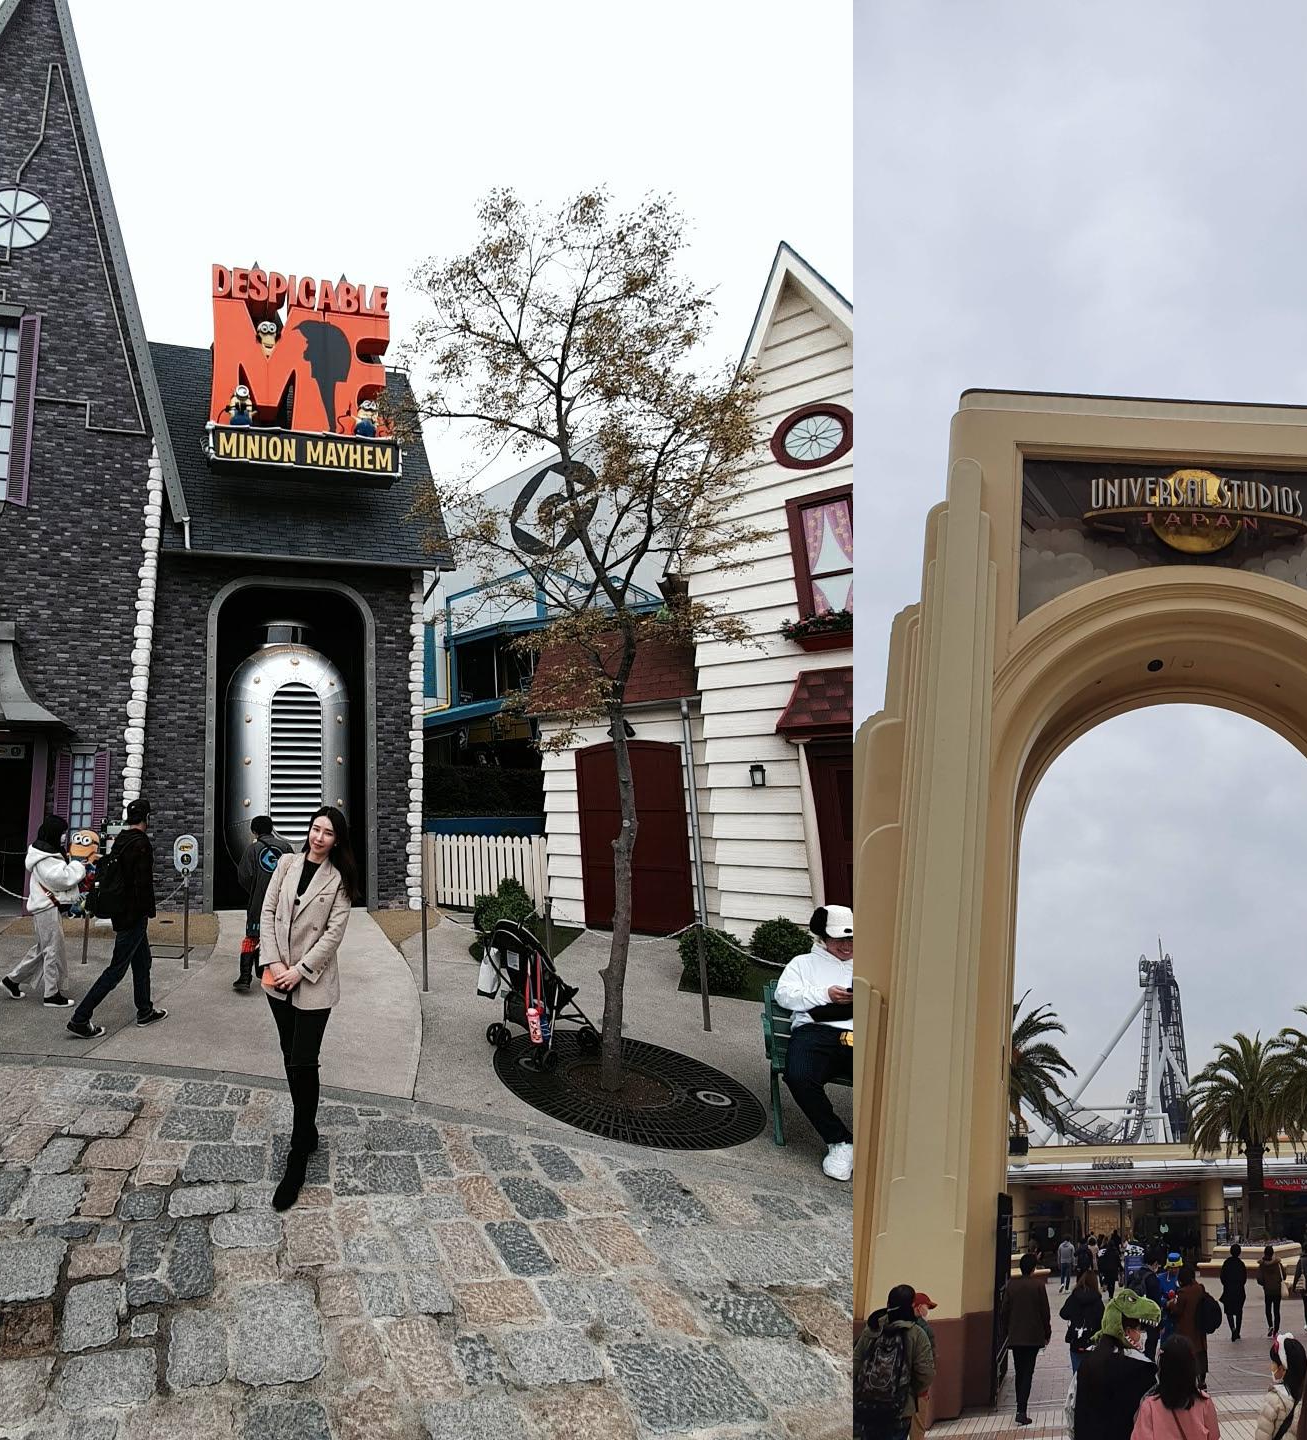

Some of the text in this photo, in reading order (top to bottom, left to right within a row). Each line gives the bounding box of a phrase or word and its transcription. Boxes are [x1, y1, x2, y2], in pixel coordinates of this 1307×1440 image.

[212, 263, 390, 317] DESPICABLE
[218, 431, 393, 472] MINION MAYHEM
[1091, 476, 1304, 518] UNIVERSAL STUDIOS
[1141, 511, 1259, 529] JAPAN
[1092, 1156, 1134, 1170] TICKETS
[1146, 1182, 1162, 1190] SALE
